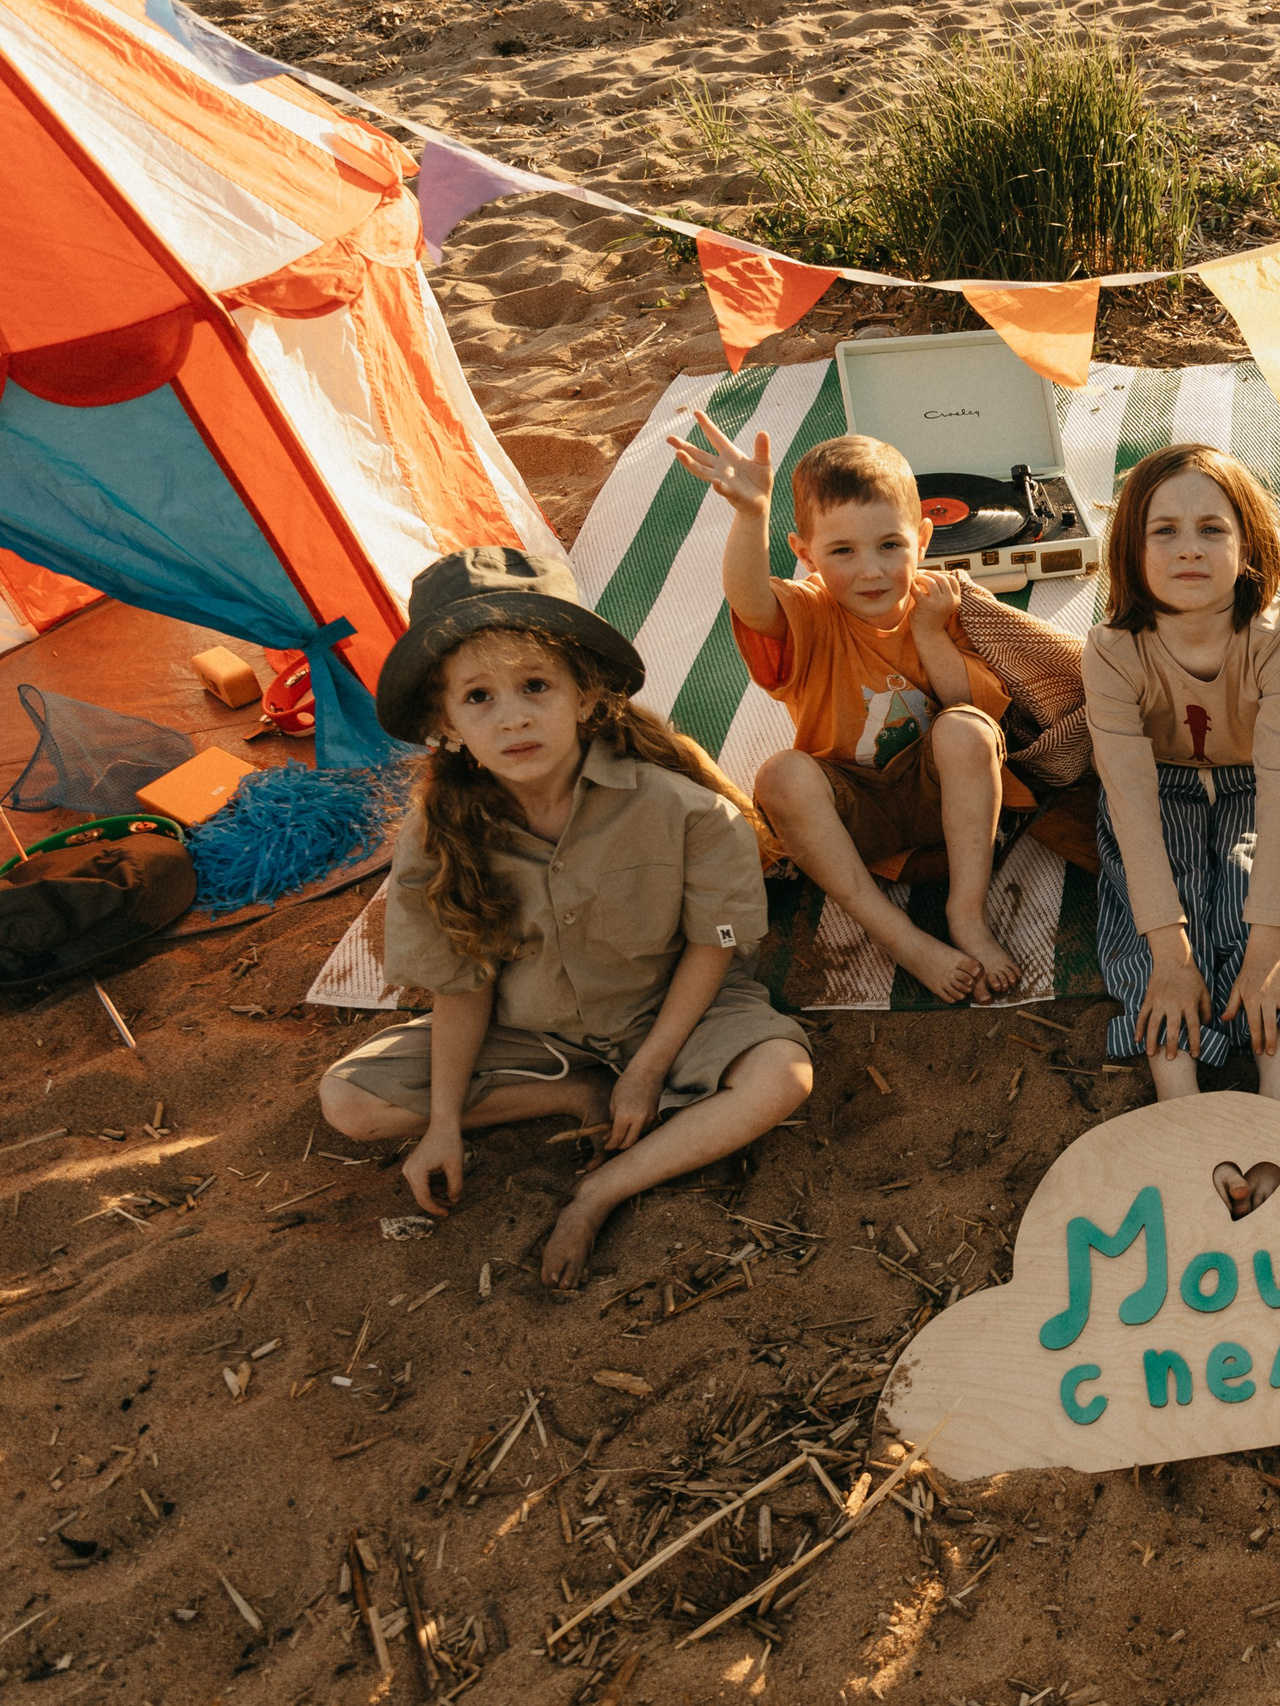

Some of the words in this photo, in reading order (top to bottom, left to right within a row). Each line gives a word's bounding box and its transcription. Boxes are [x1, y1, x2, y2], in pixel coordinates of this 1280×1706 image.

[923, 408, 980, 419] Crosley
[719, 929, 733, 940] M
[1060, 1364, 1108, 1424] с
